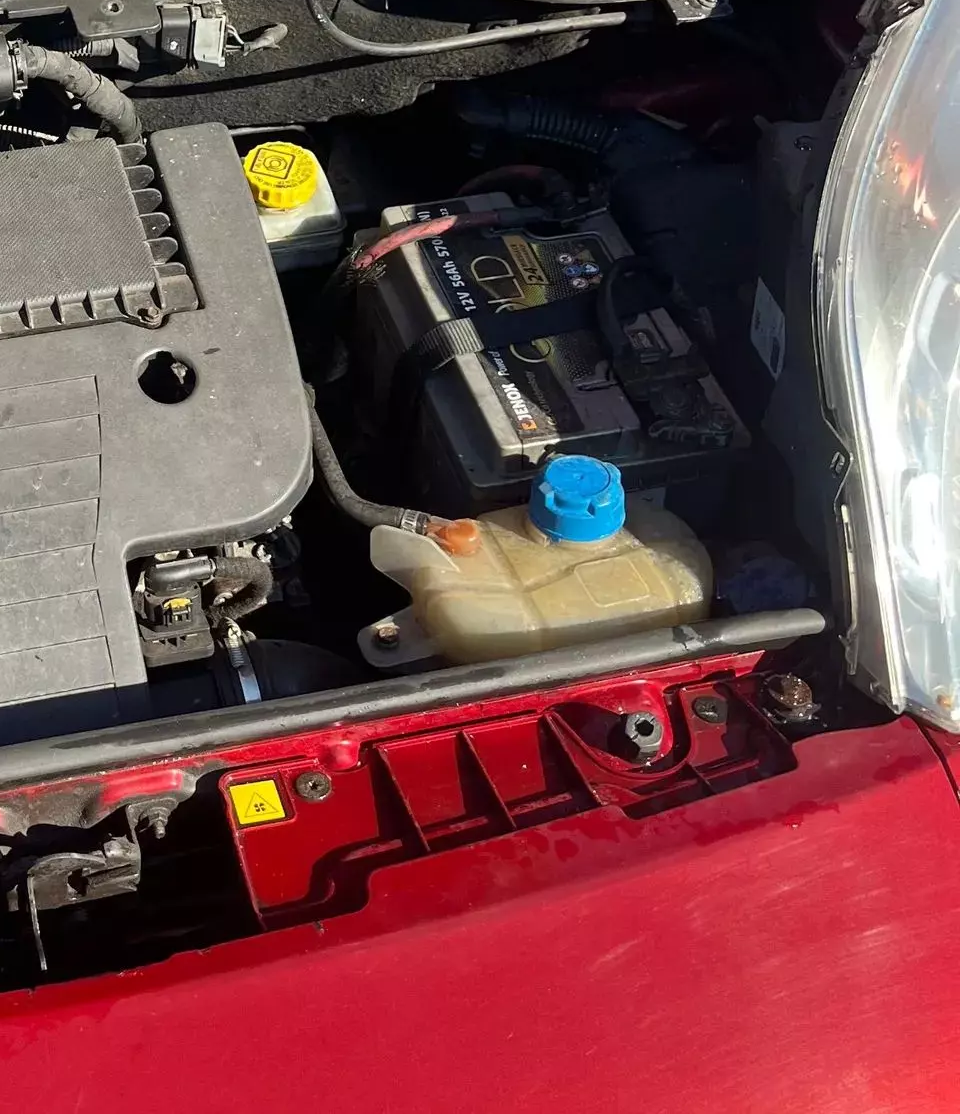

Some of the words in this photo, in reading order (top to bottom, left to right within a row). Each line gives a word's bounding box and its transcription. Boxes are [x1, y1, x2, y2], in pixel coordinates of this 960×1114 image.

[442, 260, 466, 288] 56Ah
[523, 267, 545, 283] 24
[456, 290, 477, 312] 12V
[501, 382, 533, 421] JENOX
